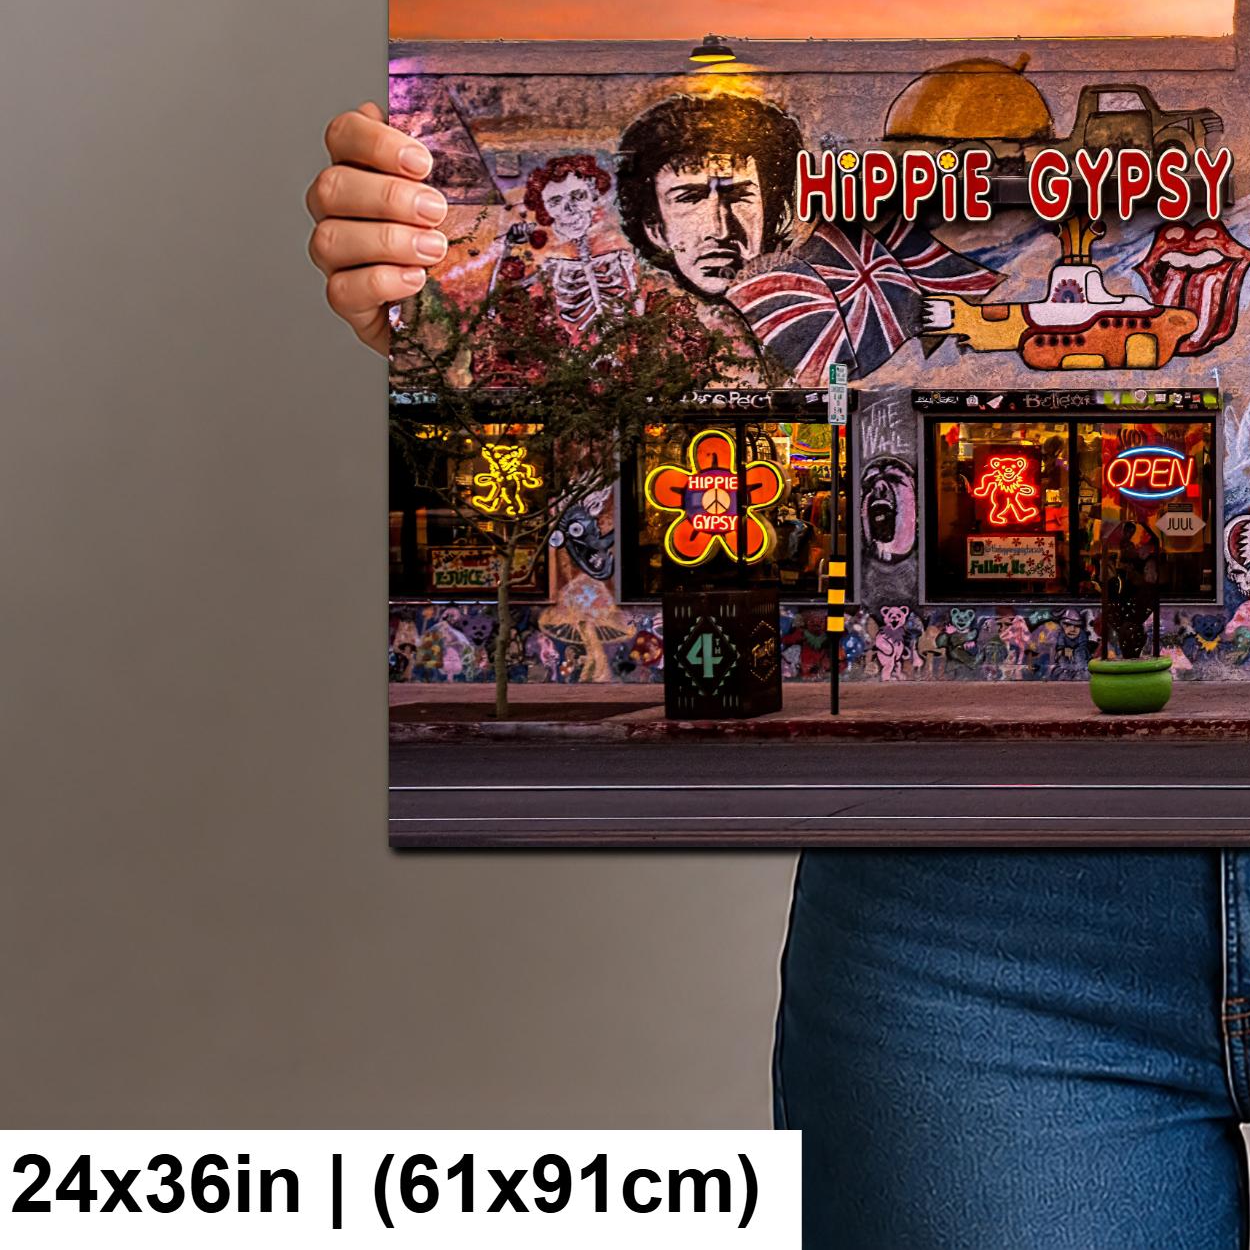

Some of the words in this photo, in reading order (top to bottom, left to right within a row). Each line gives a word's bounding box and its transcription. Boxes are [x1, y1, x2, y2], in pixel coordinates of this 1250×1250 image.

[1028, 148, 1233, 221] GYPSY
[1107, 457, 1194, 488] OPEN
[688, 476, 738, 490] HIPPIE
[693, 514, 738, 530] GYPSY
[1167, 517, 1194, 531] JUUL
